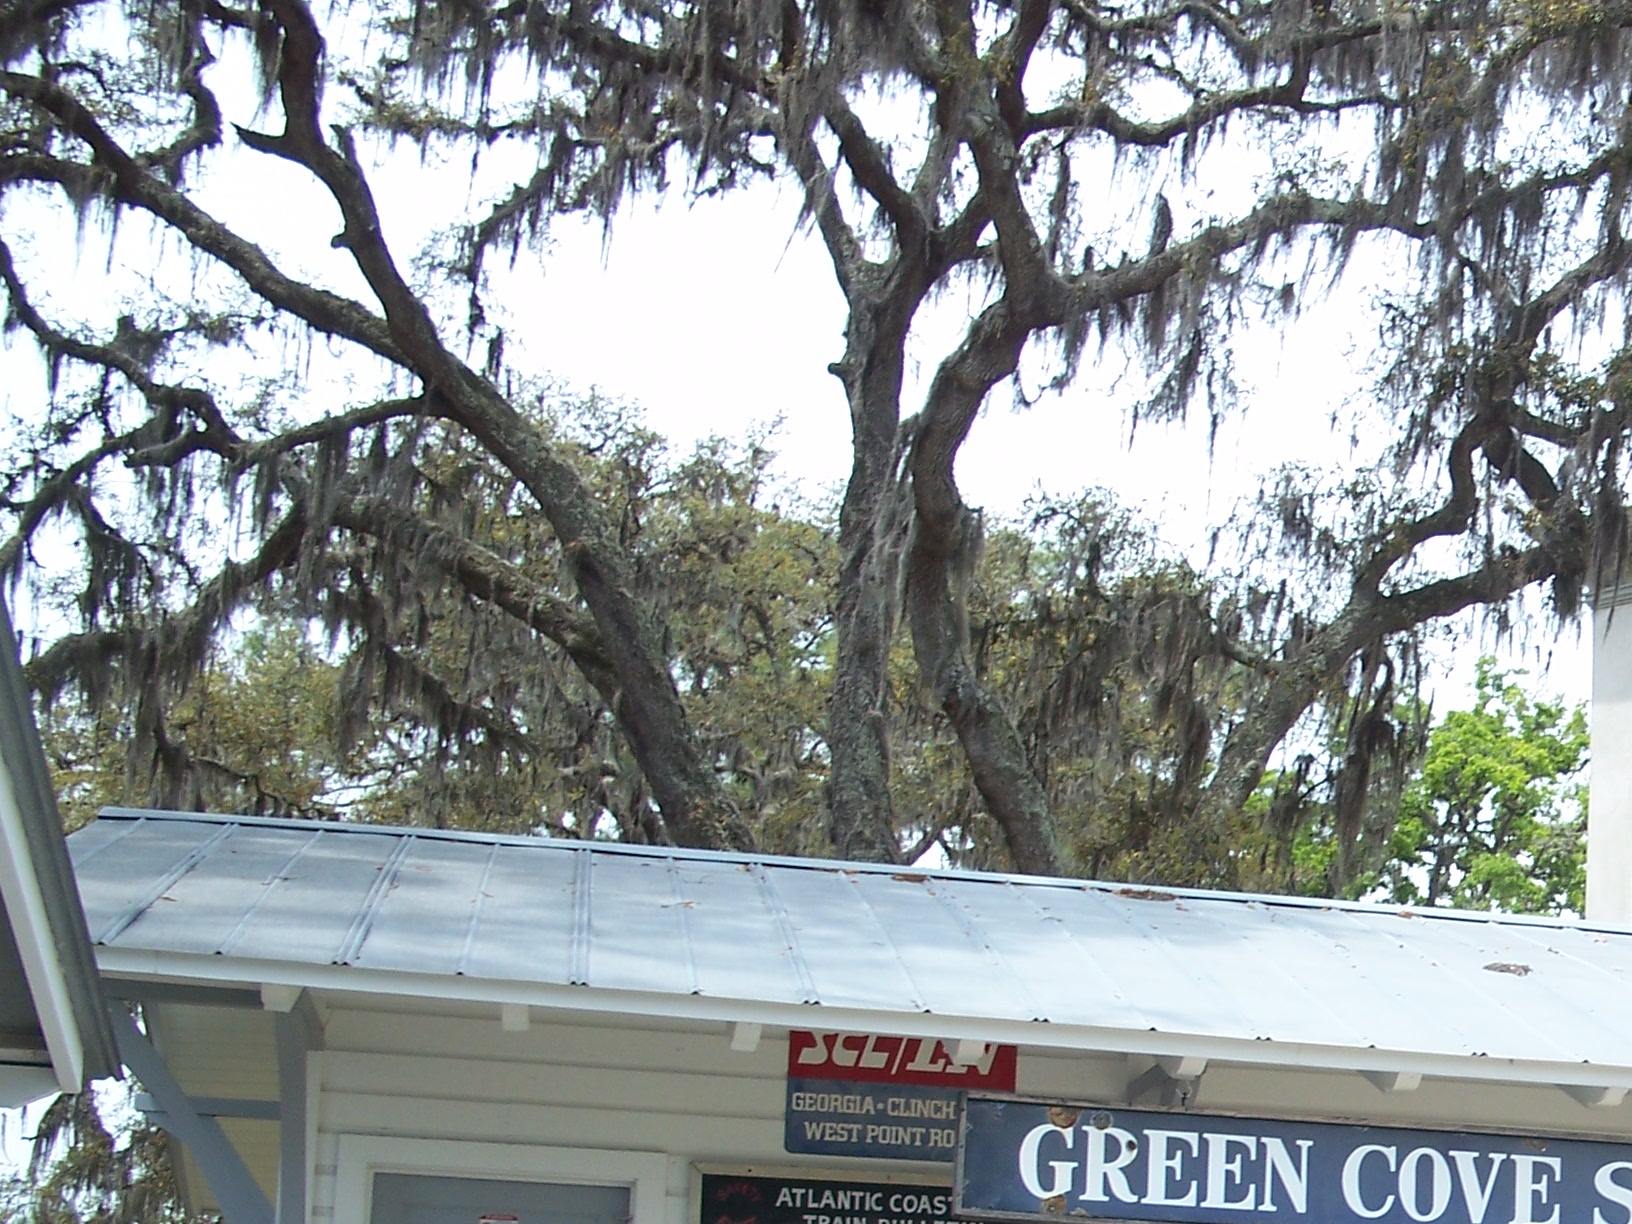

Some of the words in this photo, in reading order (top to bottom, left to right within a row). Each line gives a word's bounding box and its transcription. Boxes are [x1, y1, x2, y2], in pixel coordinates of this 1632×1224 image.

[791, 1092, 876, 1116] GEORGIA
[803, 1121, 862, 1143] WEST
[866, 1125, 926, 1147] POINT
[1017, 1121, 1316, 1215] GREEN
[775, 1187, 883, 1212] ATLANTIC
